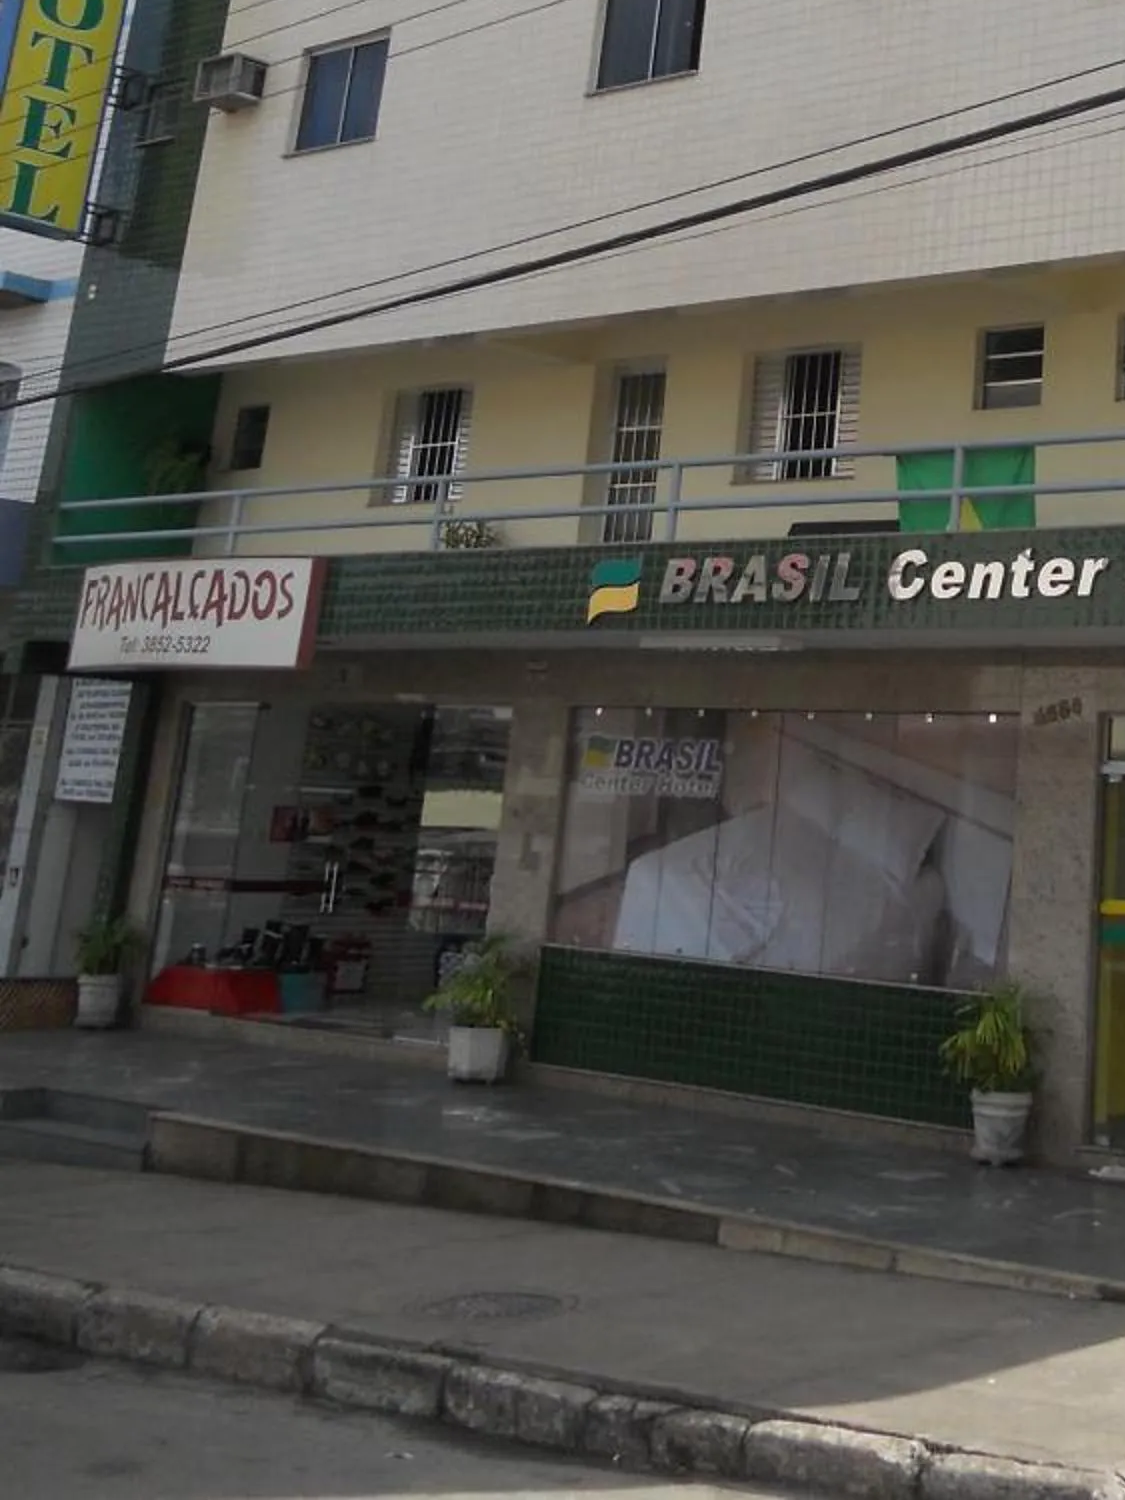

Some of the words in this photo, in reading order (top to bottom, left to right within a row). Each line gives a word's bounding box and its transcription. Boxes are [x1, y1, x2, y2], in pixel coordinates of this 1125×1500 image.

[659, 550, 861, 603] BRASIL
[888, 547, 1108, 599] Center
[614, 738, 722, 773] BRASIL
